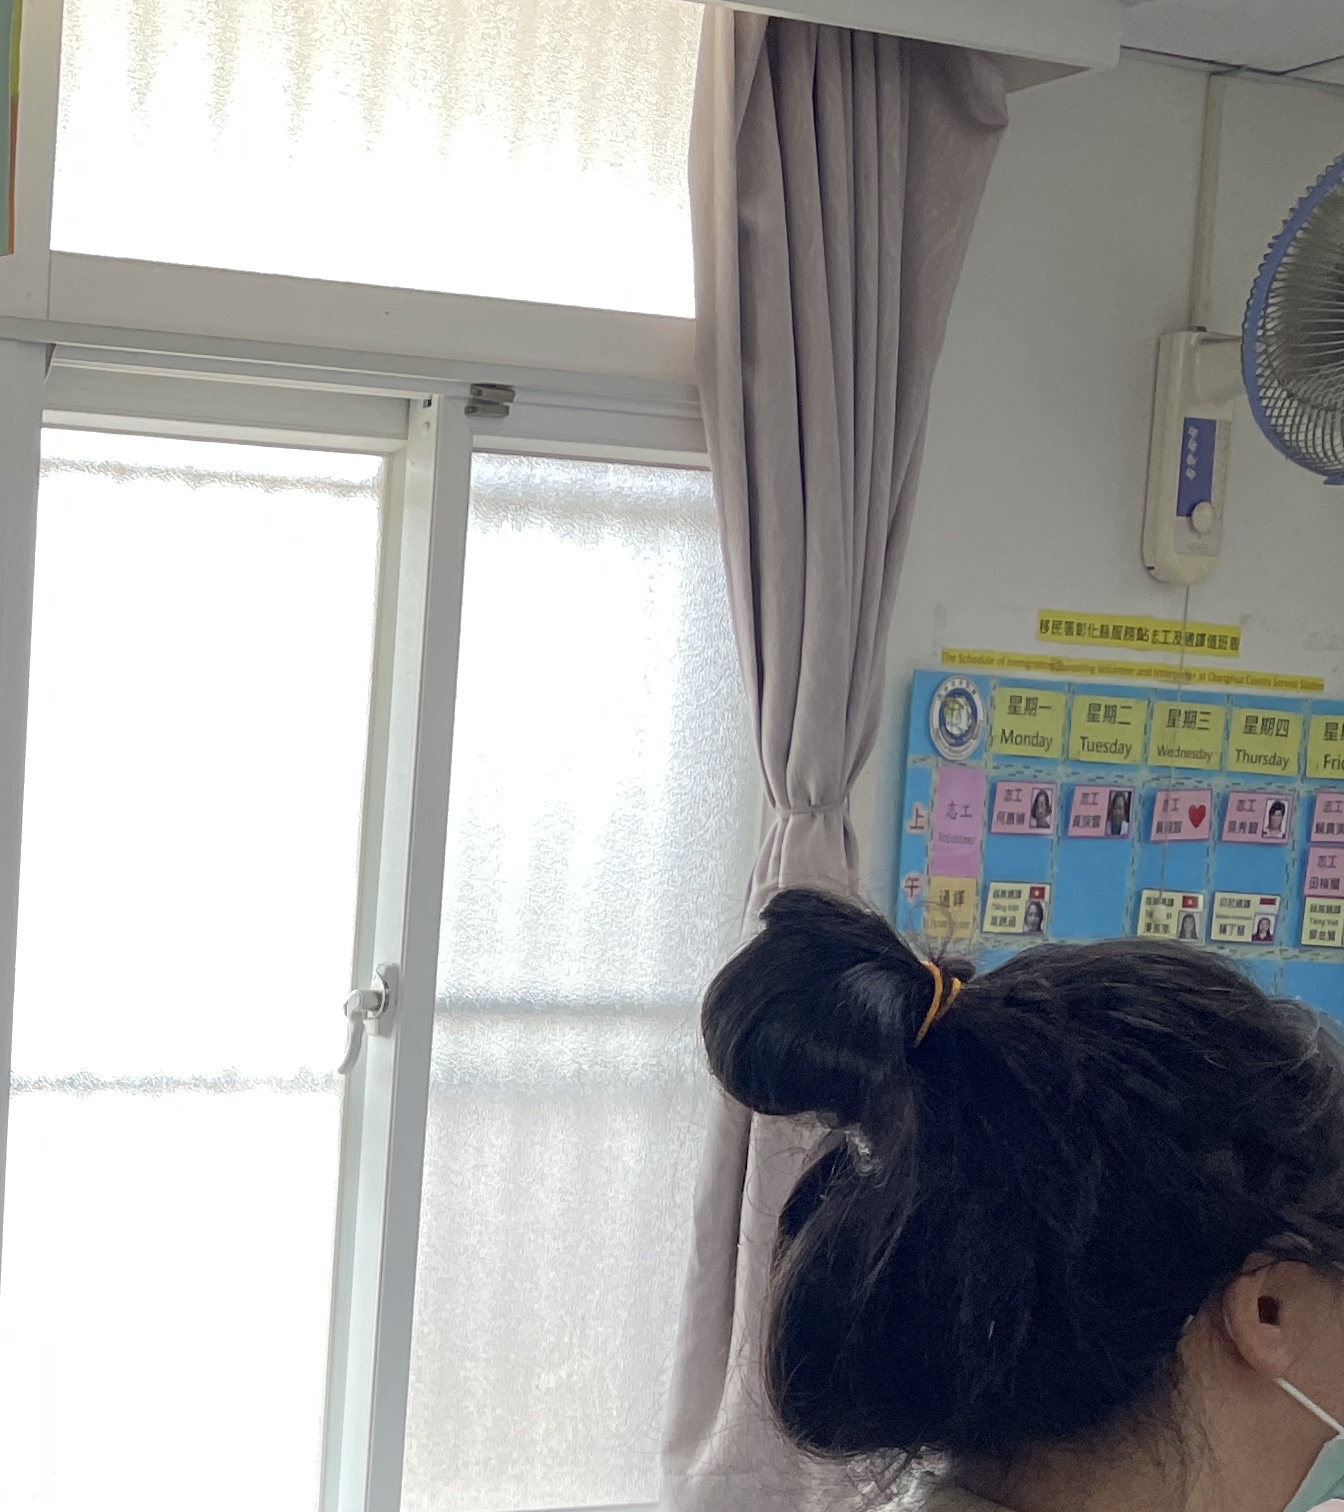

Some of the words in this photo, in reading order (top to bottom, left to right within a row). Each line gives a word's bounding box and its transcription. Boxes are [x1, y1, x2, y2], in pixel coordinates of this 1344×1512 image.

[1008, 695, 1052, 716] 星期一
[1086, 703, 1132, 725] 星期二
[1166, 709, 1212, 730] 星期三
[1243, 715, 1290, 738] 星期四
[1000, 729, 1053, 753] Monday
[1080, 736, 1132, 760] Tuesday
[1157, 744, 1214, 764] Wednesday
[1235, 748, 1290, 772] Thursday
[945, 800, 973, 820] 志工
